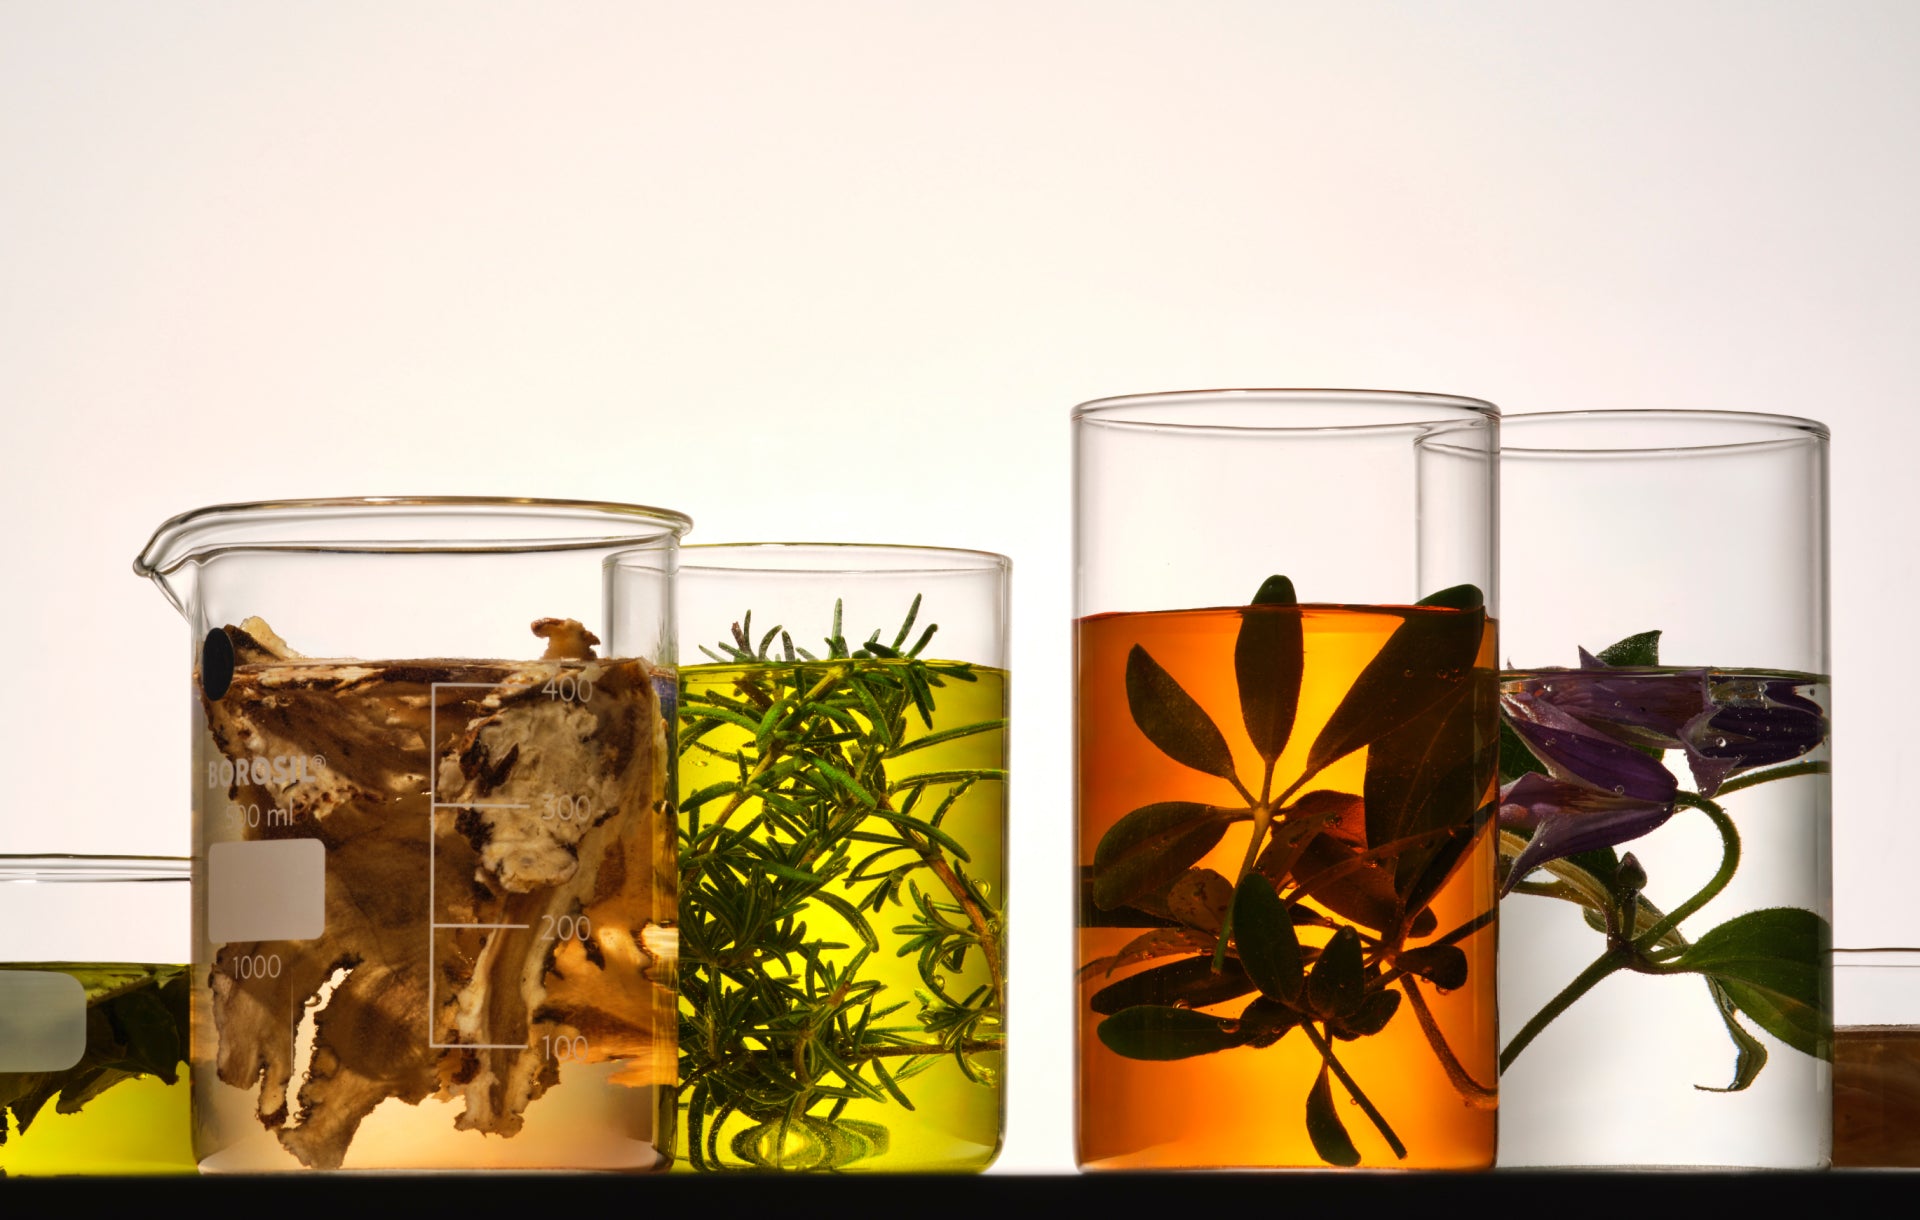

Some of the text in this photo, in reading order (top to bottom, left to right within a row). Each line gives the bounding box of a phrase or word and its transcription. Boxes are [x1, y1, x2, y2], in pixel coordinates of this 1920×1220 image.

[542, 676, 592, 702] 400
[267, 798, 293, 827] ml
[542, 794, 591, 820] 300
[541, 915, 591, 941] 200
[233, 955, 281, 979] 1000
[542, 1035, 588, 1061] 100
